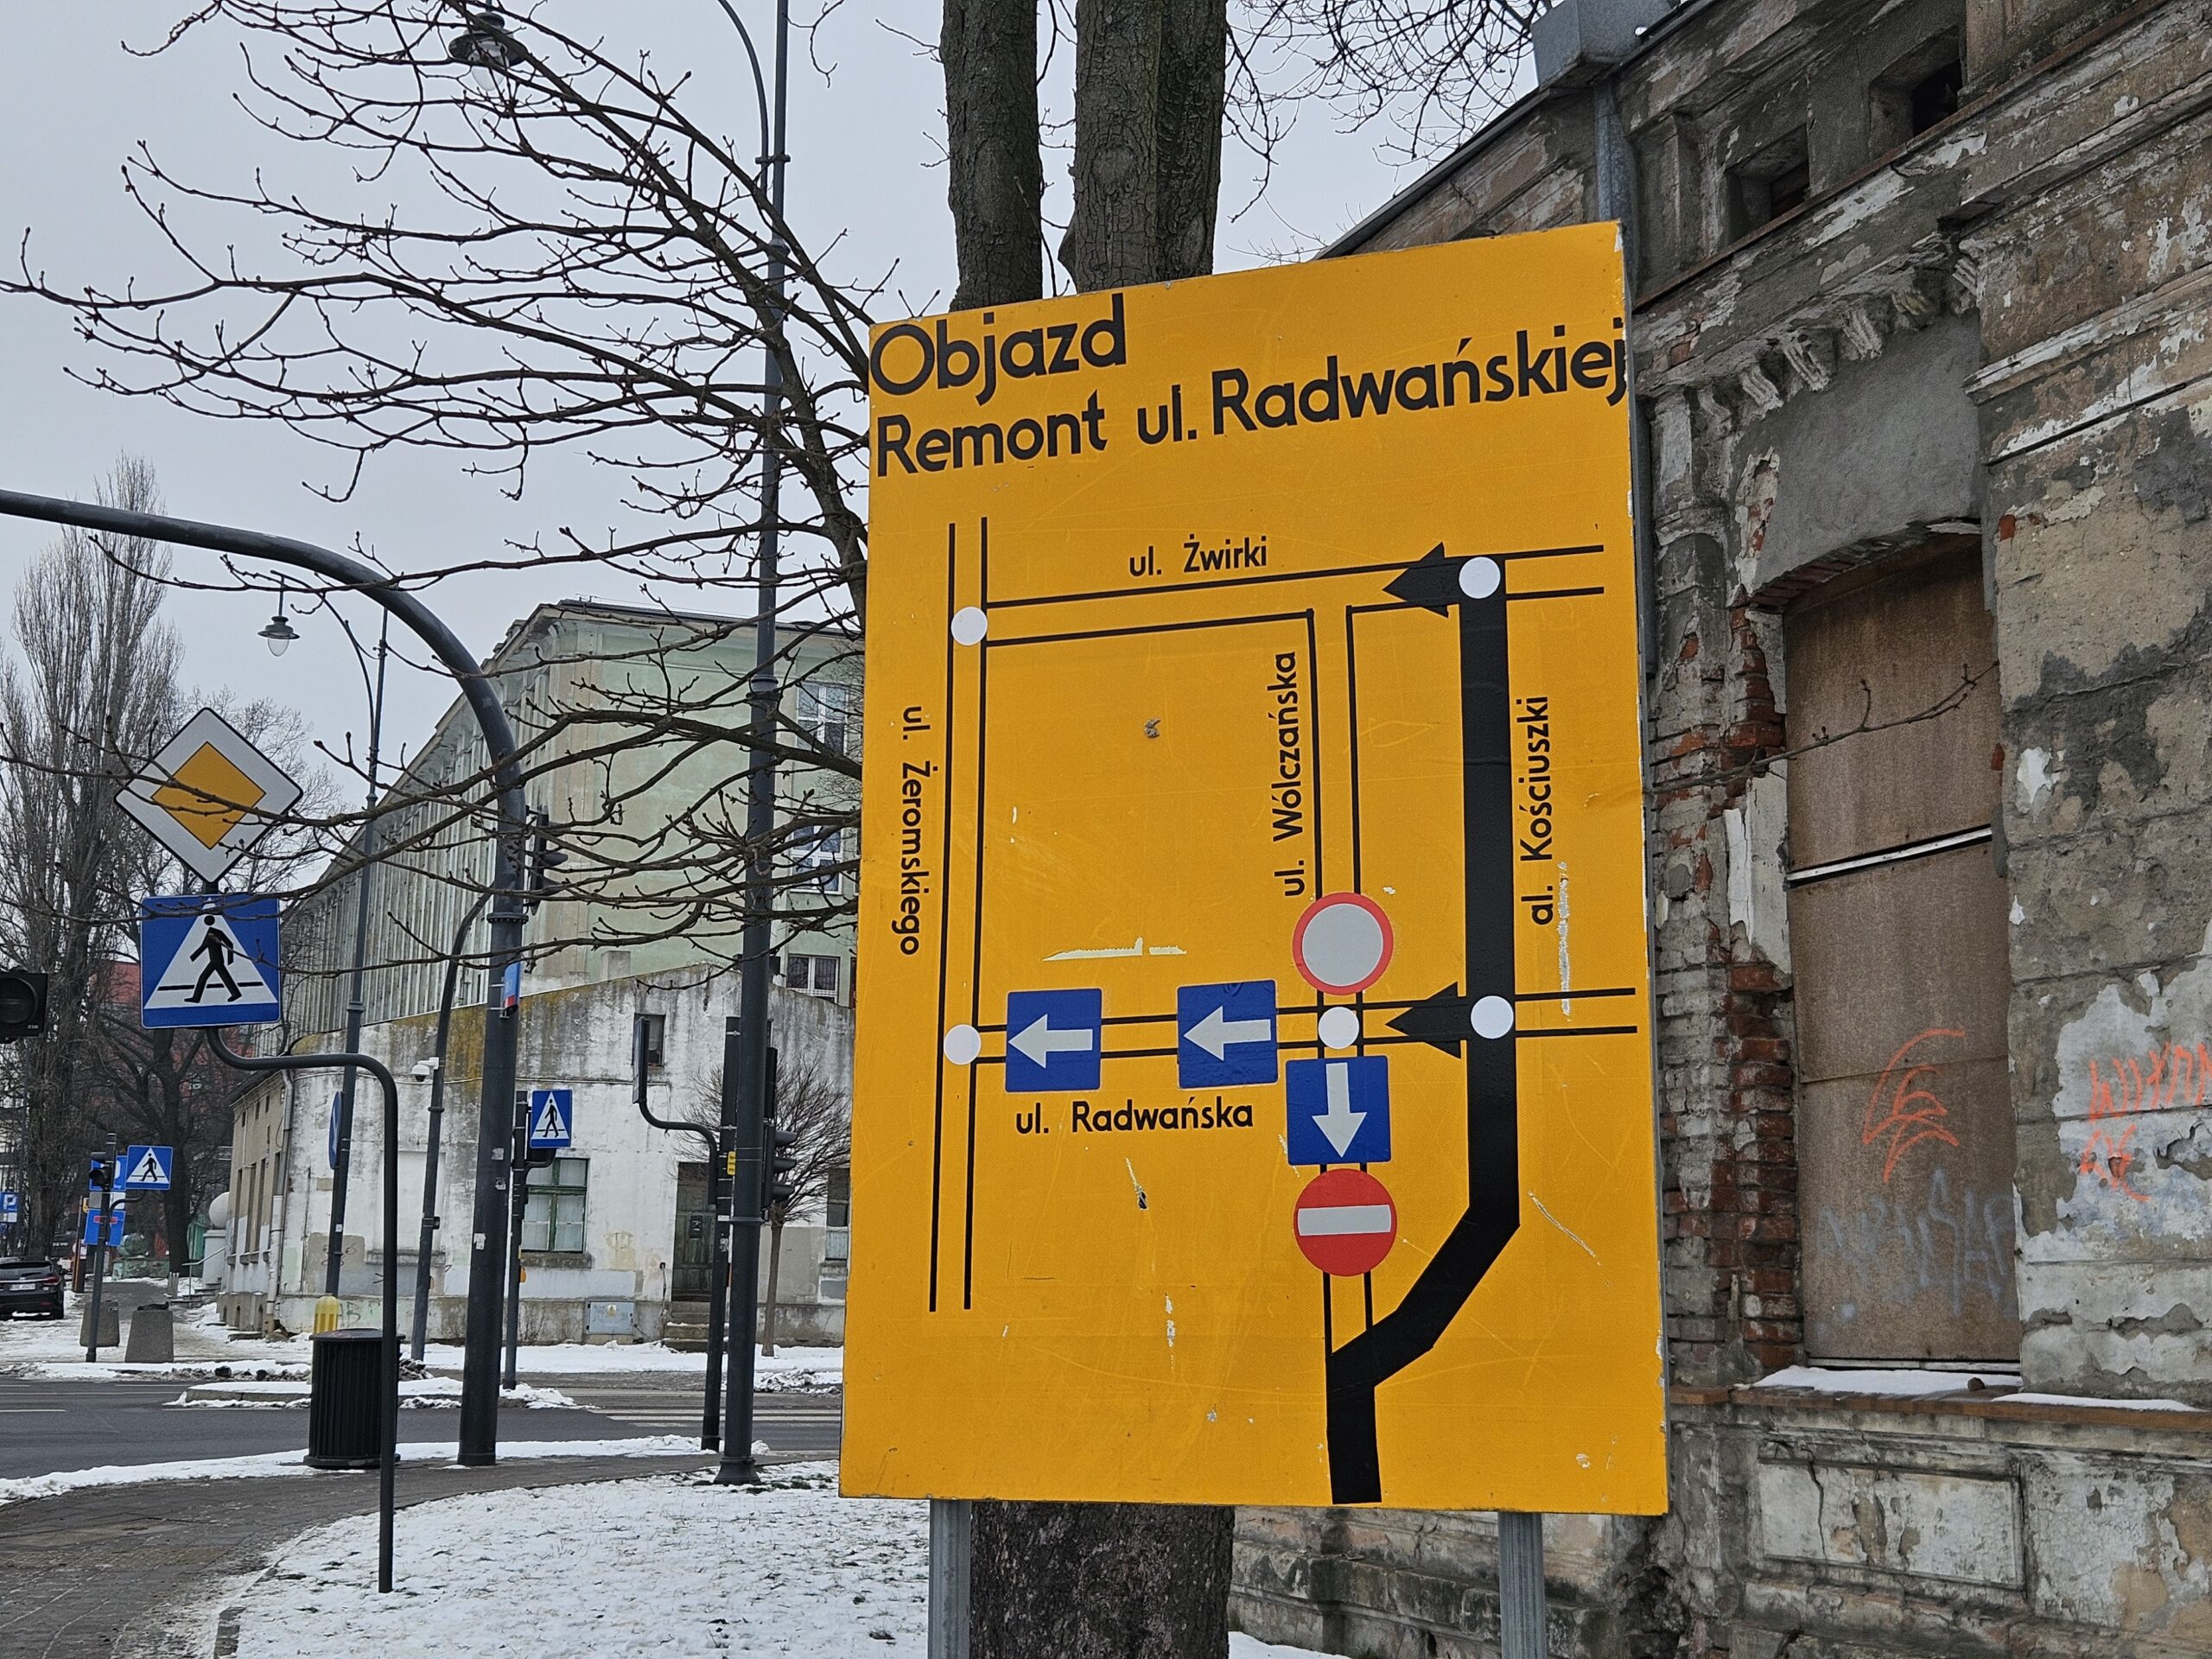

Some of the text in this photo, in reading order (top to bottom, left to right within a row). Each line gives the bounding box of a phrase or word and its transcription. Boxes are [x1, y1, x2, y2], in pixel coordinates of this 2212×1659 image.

[869, 292, 1127, 407] Objazd
[877, 315, 1627, 478] Remont ul. Radwańskiej
[1129, 533, 1268, 577] ul. Żwirki
[891, 706, 938, 957] ul. Żeromskiego
[1267, 651, 1306, 898] ul. Wólczańska
[1516, 696, 1554, 925] al. Kościuszki
[1015, 1095, 1254, 1135] ul. Radwańska
